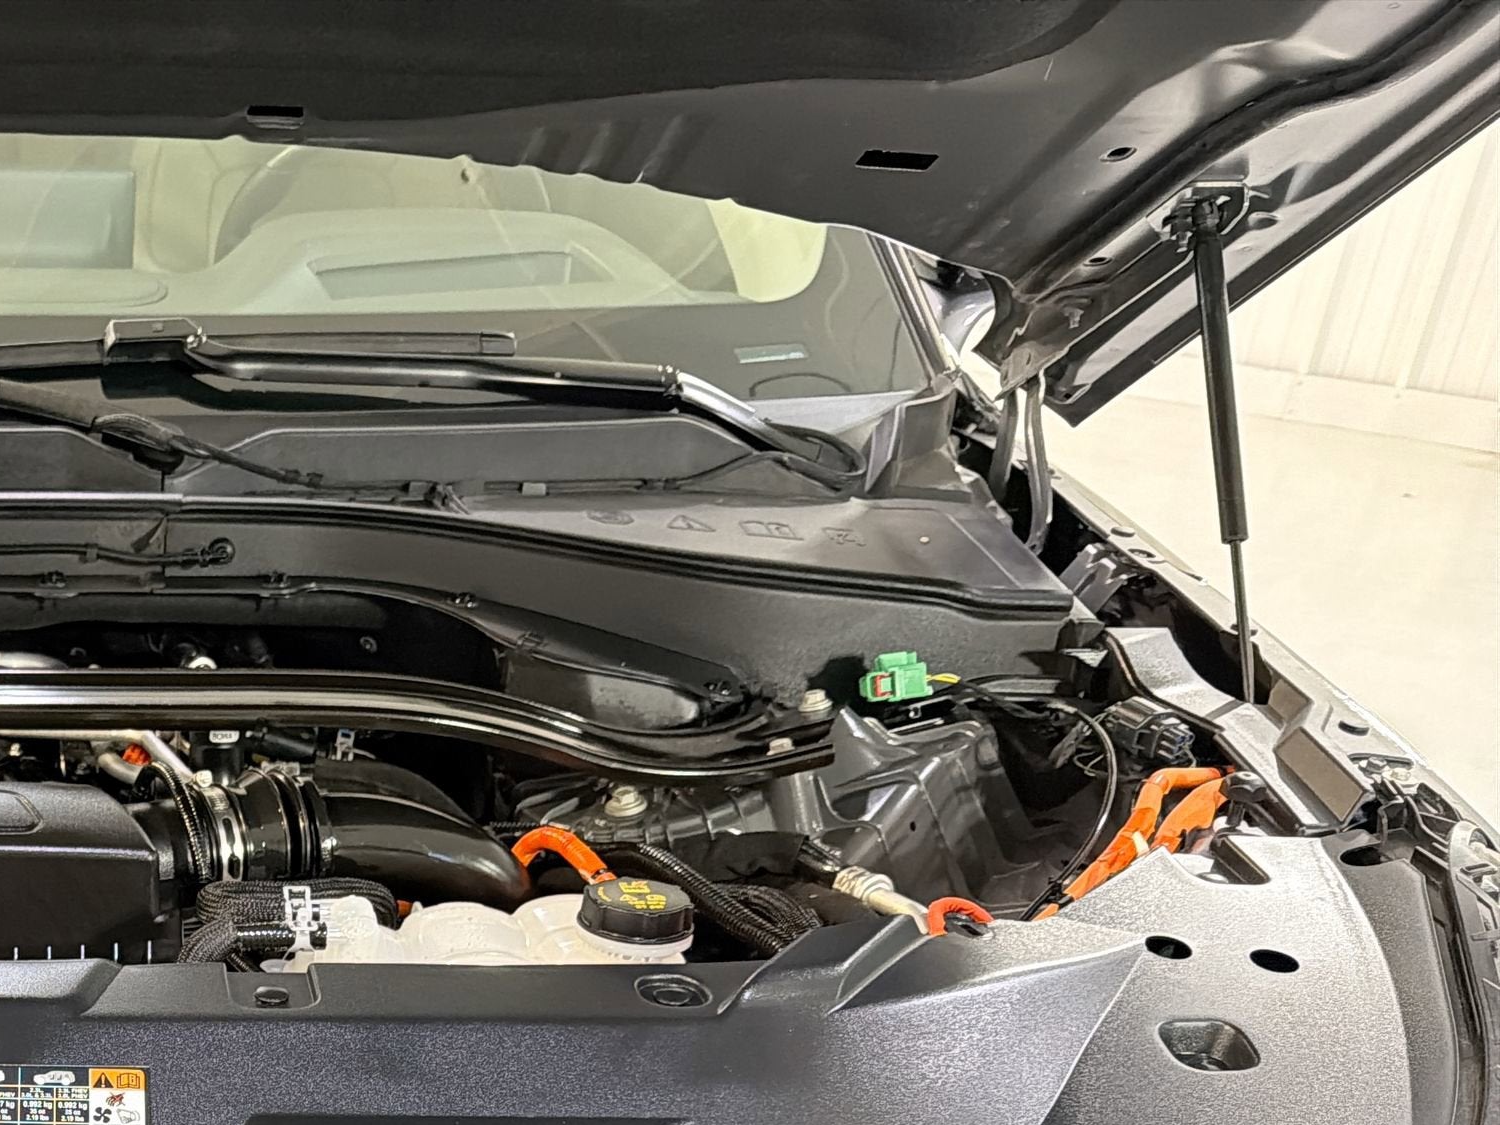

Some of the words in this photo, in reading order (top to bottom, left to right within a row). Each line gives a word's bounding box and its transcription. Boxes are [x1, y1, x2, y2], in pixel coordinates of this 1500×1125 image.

[5, 1100, 15, 1109] kg
[43, 1101, 53, 1110] kg
[78, 1102, 88, 1110] kg
